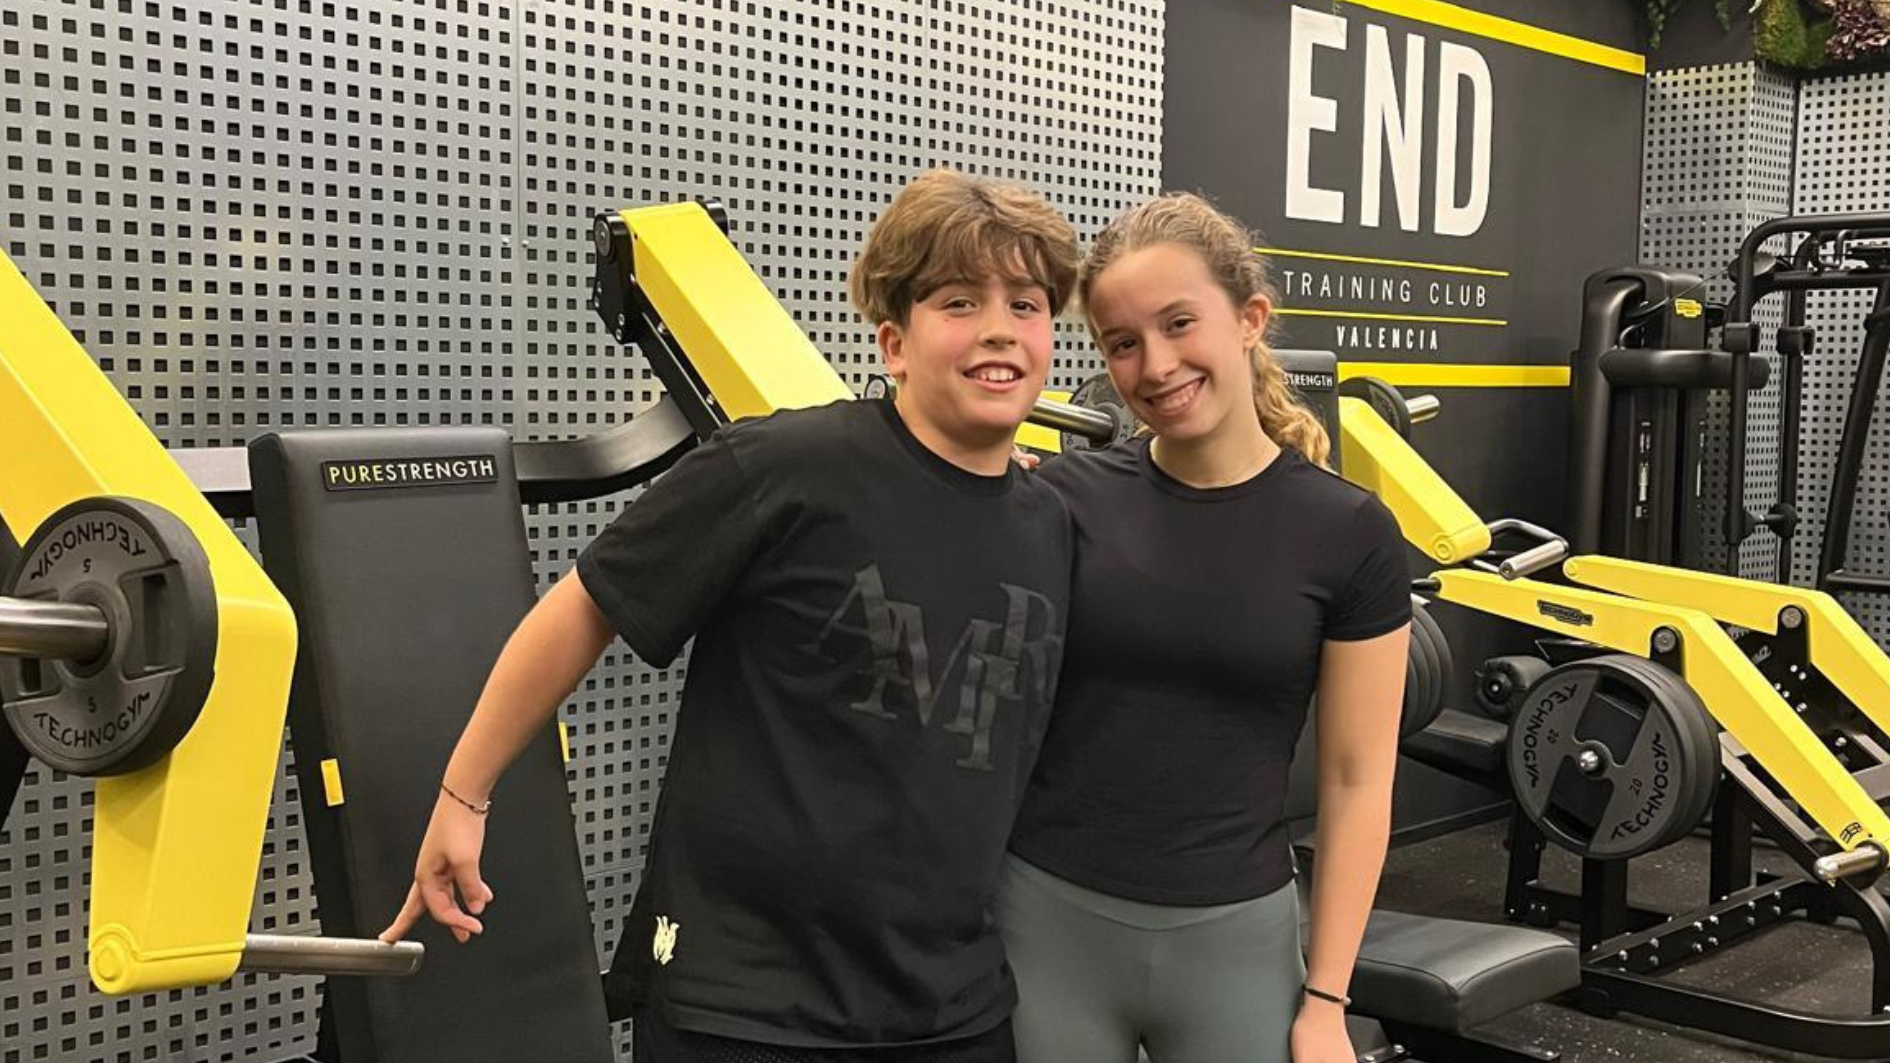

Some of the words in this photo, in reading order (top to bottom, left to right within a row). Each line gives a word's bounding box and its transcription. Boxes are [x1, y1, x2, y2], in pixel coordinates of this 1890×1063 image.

[1285, 4, 1493, 237] END
[1283, 270, 1412, 303] TRAINING
[1429, 282, 1487, 307] CLUB
[1336, 325, 1438, 350] VALENCIA
[328, 459, 494, 484] PURESTRENGTH
[30, 521, 147, 580] TECHNOGYM
[83, 557, 92, 573] 5
[33, 691, 151, 747] TECHNOGYM
[88, 698, 97, 712] 5
[1611, 732, 1669, 840] TECHNOGYM
[1629, 778, 1643, 795] 20
